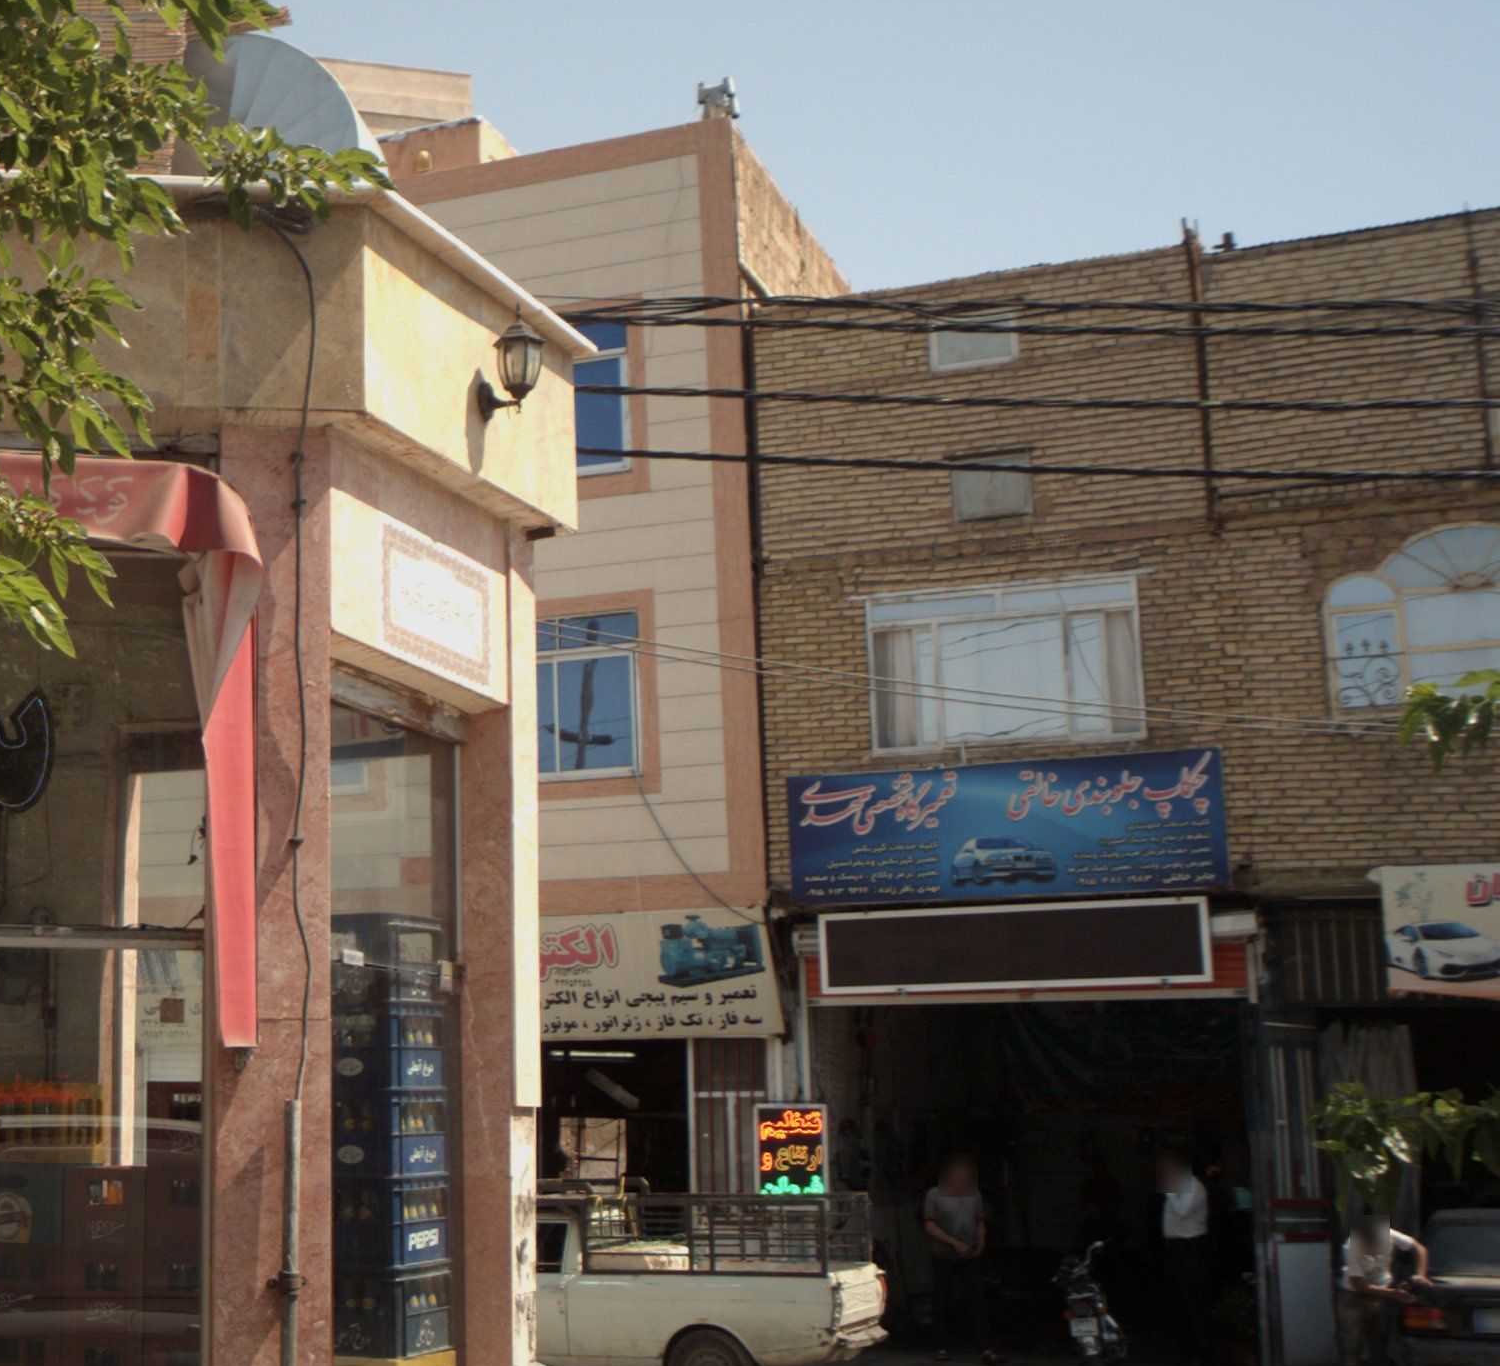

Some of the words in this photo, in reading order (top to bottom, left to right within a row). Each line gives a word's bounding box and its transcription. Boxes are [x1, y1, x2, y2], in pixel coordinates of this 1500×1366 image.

[1007, 770, 1062, 821] خالقی
[1061, 769, 1144, 816] جلوبندی
[583, 989, 620, 1009] انواع
[625, 992, 666, 1008] پیچی
[671, 993, 699, 1006] سیم
[705, 990, 713, 1005] و
[718, 985, 757, 1006] تعمیر
[543, 1017, 578, 1034] موتور
[593, 1015, 642, 1033] ژنراتور
[657, 1012, 675, 1031] فاز
[680, 1012, 703, 1026] تک
[718, 1011, 739, 1030] فاز
[743, 1015, 763, 1025] سه
[759, 1109, 823, 1141] تنظیم
[760, 1151, 773, 1172] و
[775, 1144, 823, 1172] ارتفاع
[408, 1228, 439, 1251] PEPSI
